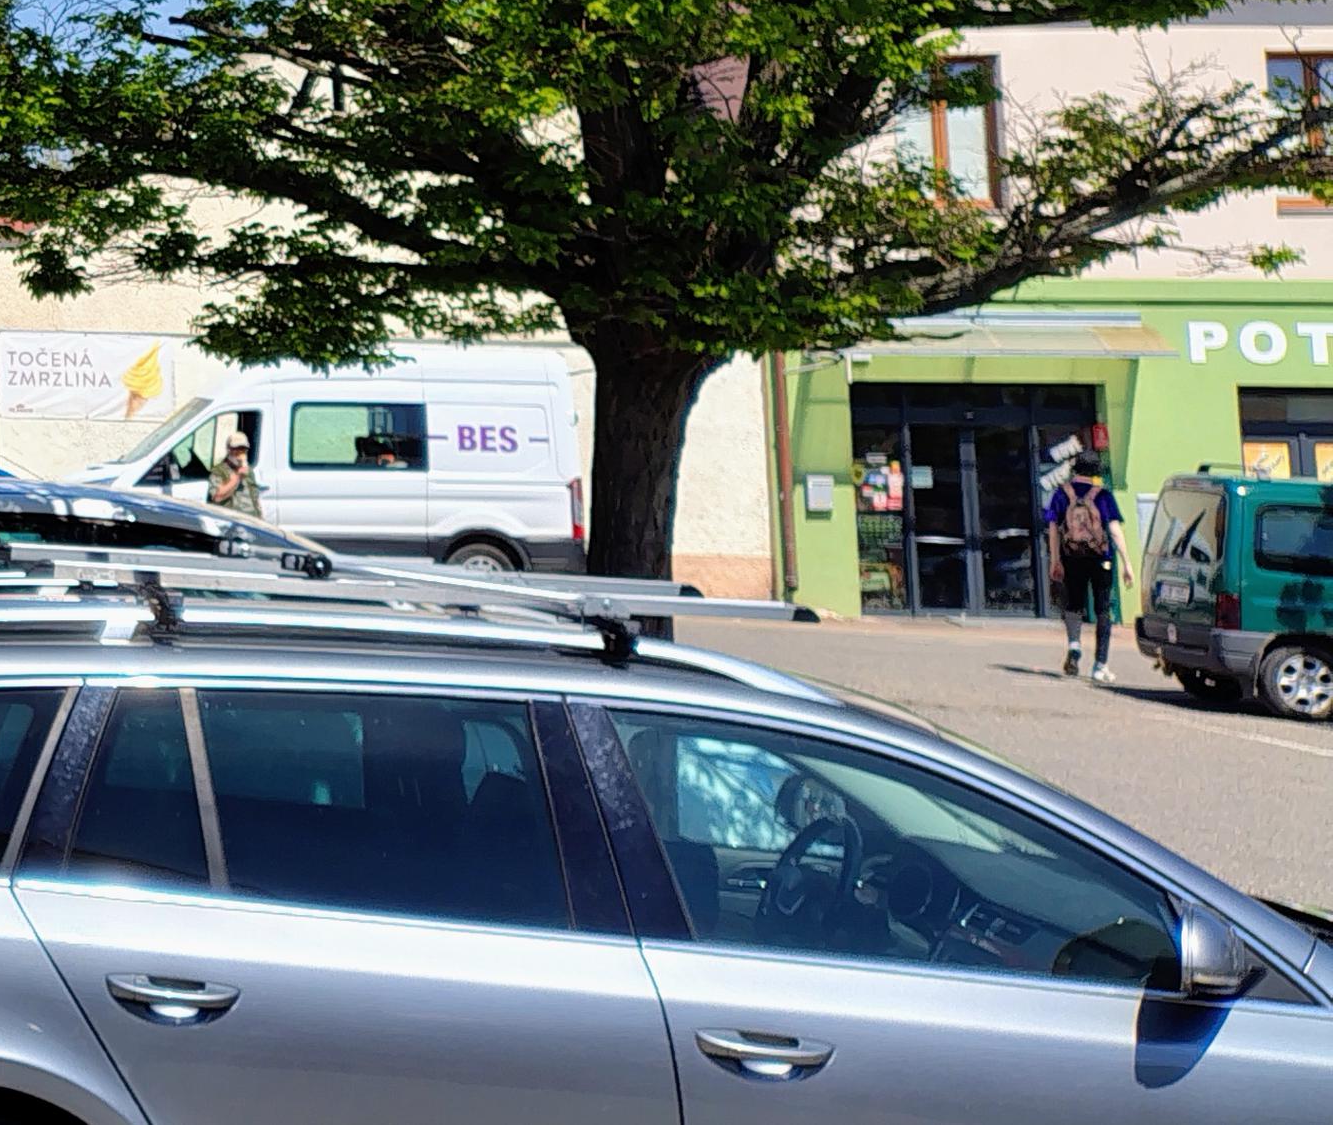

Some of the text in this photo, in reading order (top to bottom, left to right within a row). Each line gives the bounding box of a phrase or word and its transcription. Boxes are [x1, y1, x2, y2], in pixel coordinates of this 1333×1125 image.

[6, 347, 94, 368] TOČENÁ
[7, 370, 112, 388] ZMRZLINA
[457, 424, 519, 453] BES
